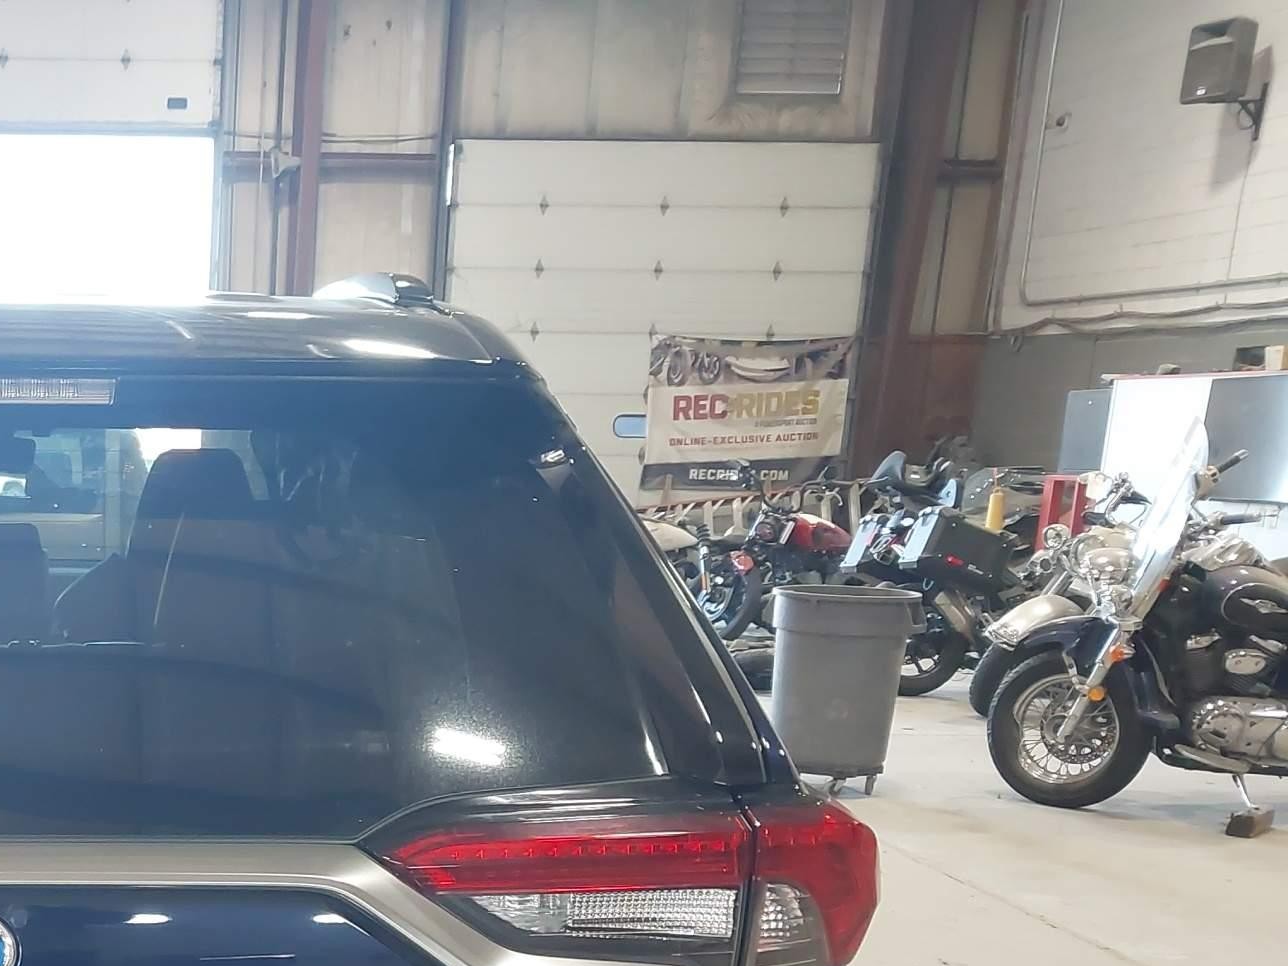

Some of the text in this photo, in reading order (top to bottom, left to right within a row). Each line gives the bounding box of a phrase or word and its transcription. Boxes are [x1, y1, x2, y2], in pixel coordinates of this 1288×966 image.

[673, 389, 820, 421] REC RIDES
[669, 432, 819, 446] ONLINE-EXCLUSIVE AUCTION
